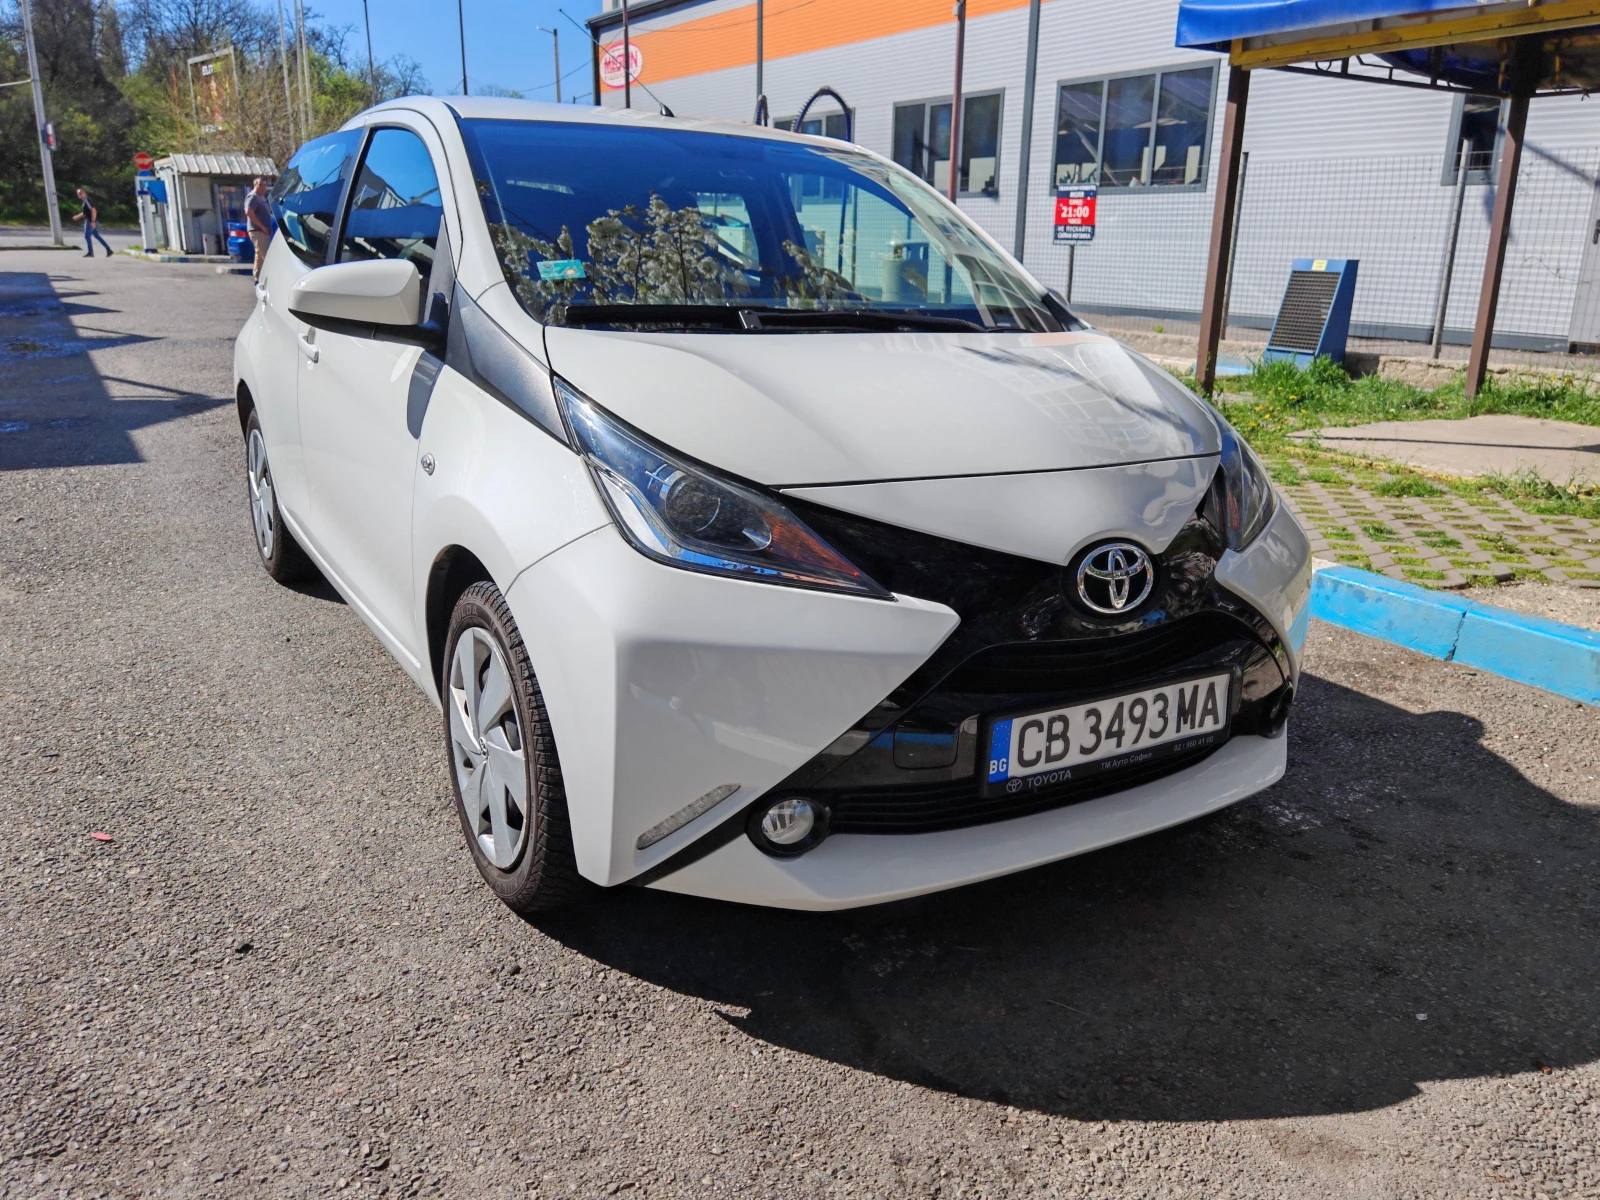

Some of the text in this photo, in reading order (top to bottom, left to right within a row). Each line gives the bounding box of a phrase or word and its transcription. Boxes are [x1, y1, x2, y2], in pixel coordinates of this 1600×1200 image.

[1060, 205, 1090, 218] 21:00
[1079, 692, 1170, 756] 3493
[1175, 681, 1220, 734] MA
[989, 757, 1007, 775] BG
[1026, 769, 1072, 788] TOYOTA
